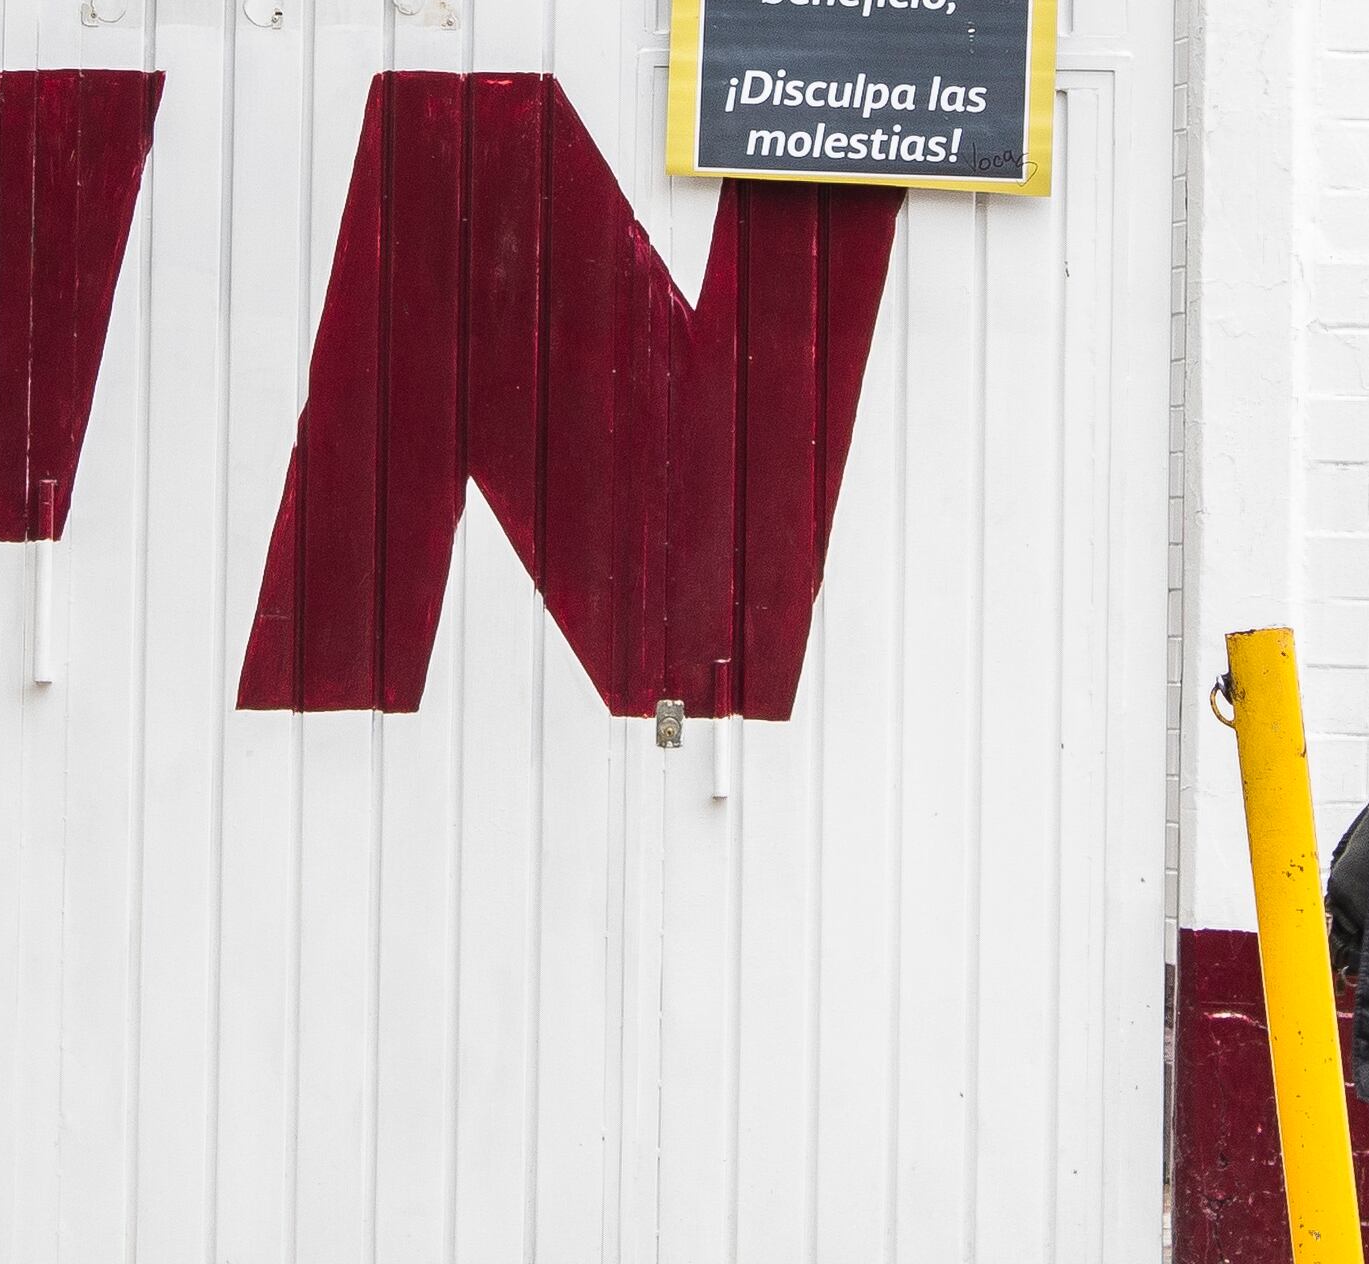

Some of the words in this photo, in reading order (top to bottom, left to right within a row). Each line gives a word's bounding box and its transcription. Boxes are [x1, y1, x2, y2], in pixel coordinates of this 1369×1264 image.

[724, 69, 916, 119] ¡Disculpa
[927, 76, 988, 114] las
[745, 123, 963, 164] molestias!
